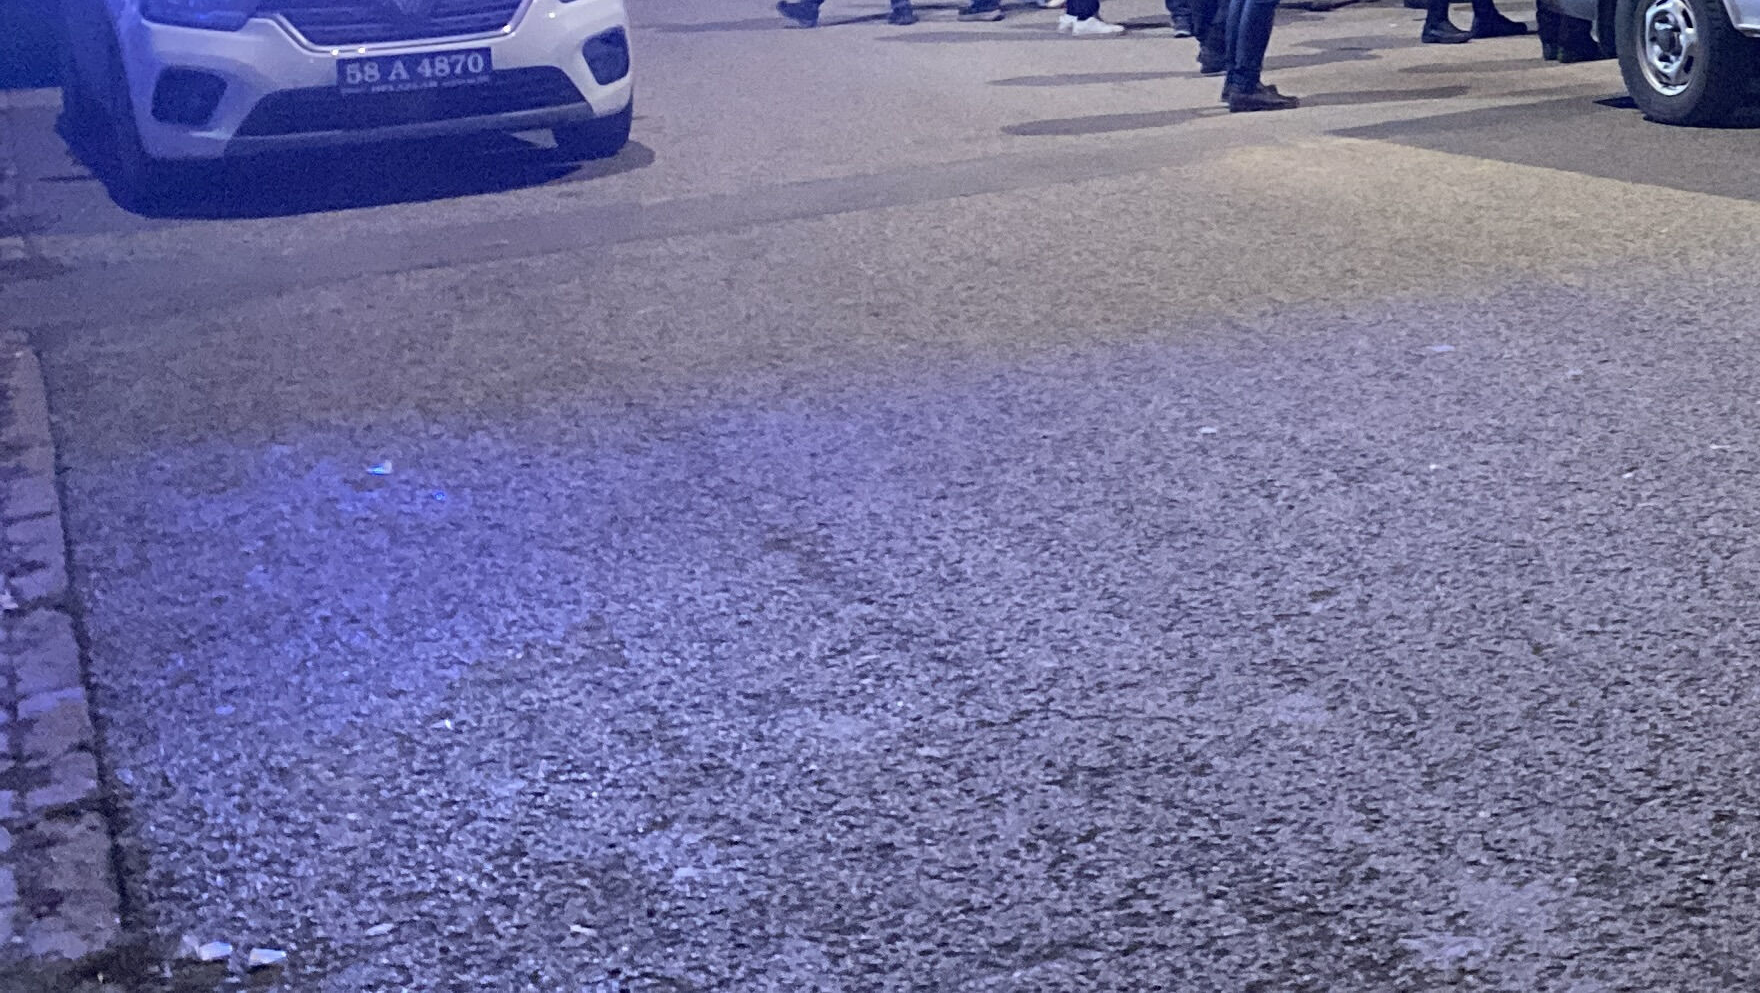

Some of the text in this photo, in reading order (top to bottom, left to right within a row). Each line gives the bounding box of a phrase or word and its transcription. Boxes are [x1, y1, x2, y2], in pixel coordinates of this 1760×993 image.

[345, 60, 381, 85] 58
[387, 59, 410, 82] A
[416, 52, 484, 78] 4870
